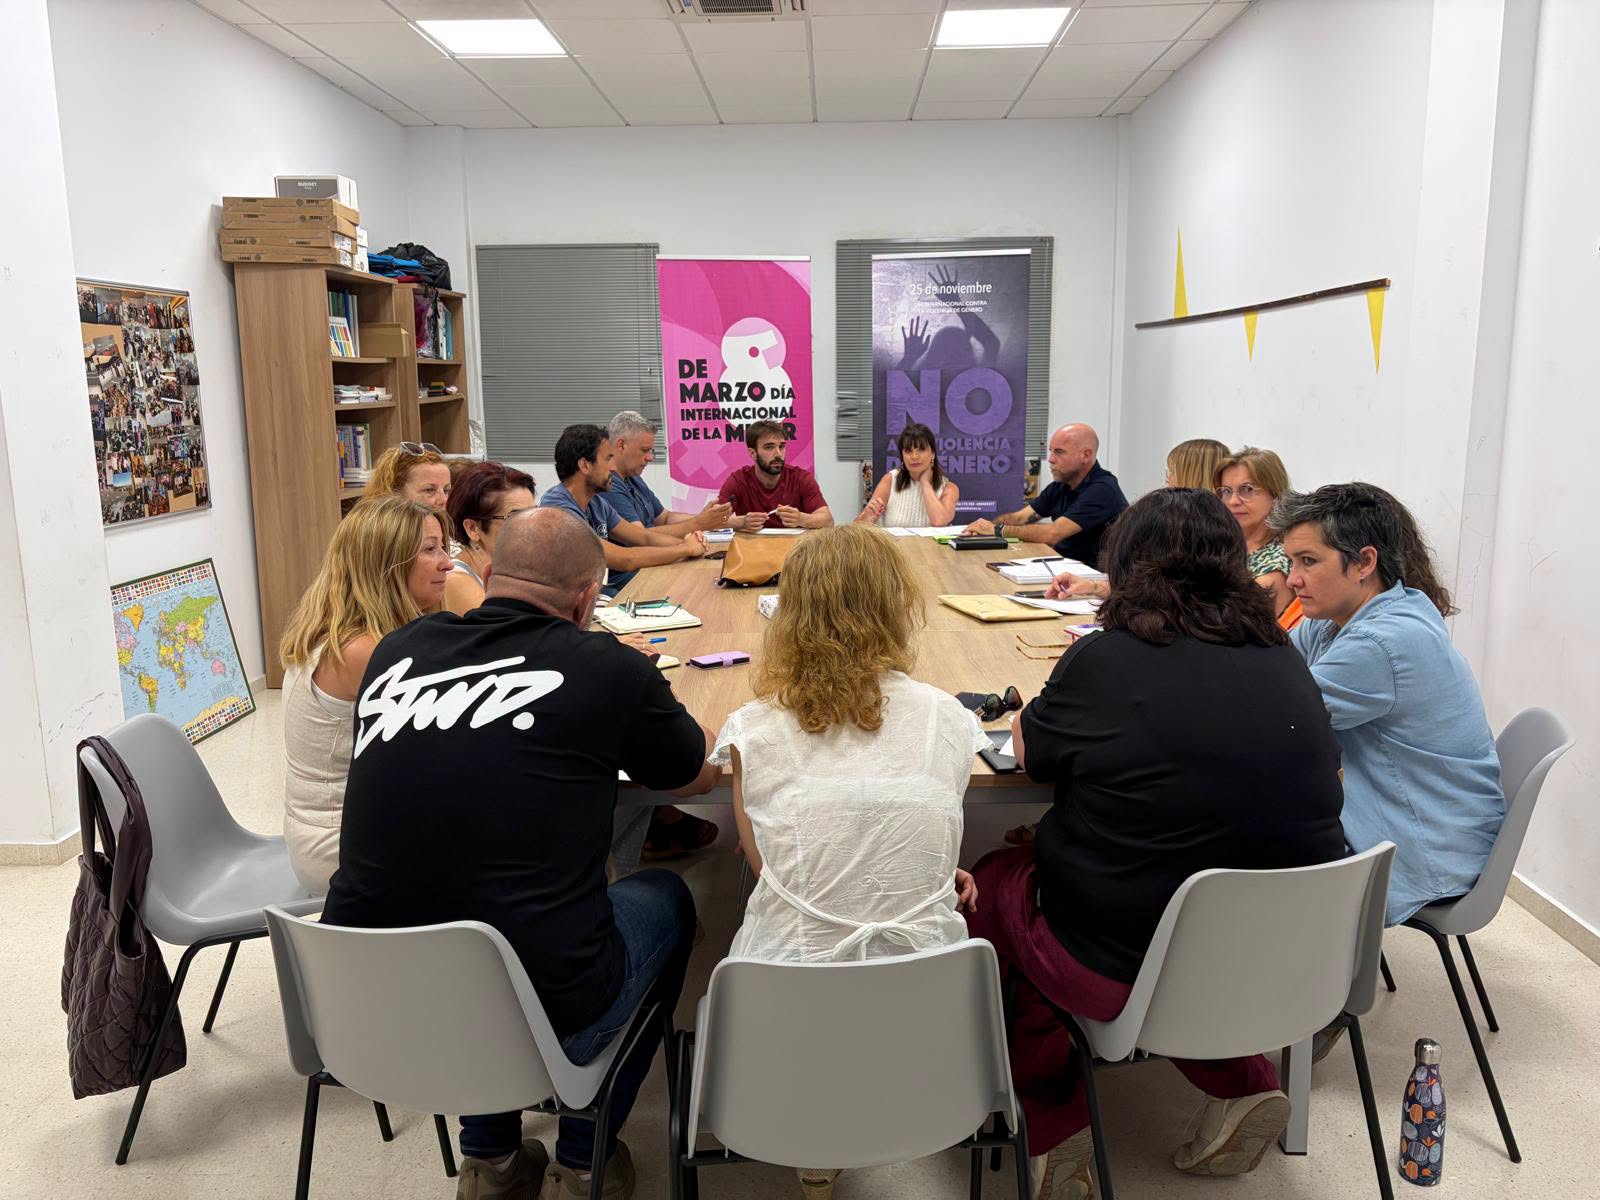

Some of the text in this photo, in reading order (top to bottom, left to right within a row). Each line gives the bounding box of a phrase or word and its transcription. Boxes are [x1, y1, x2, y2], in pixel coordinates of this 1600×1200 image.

[910, 282, 992, 295] 25 de noviembre
[678, 358, 708, 379] DE
[680, 381, 795, 403] MARZO DÍA
[886, 367, 1013, 436] NO
[680, 406, 797, 421] INTERNACIONAL
[682, 428, 700, 440] DE
[703, 427, 722, 439] LA
[936, 437, 1011, 451] IOLENCIA
